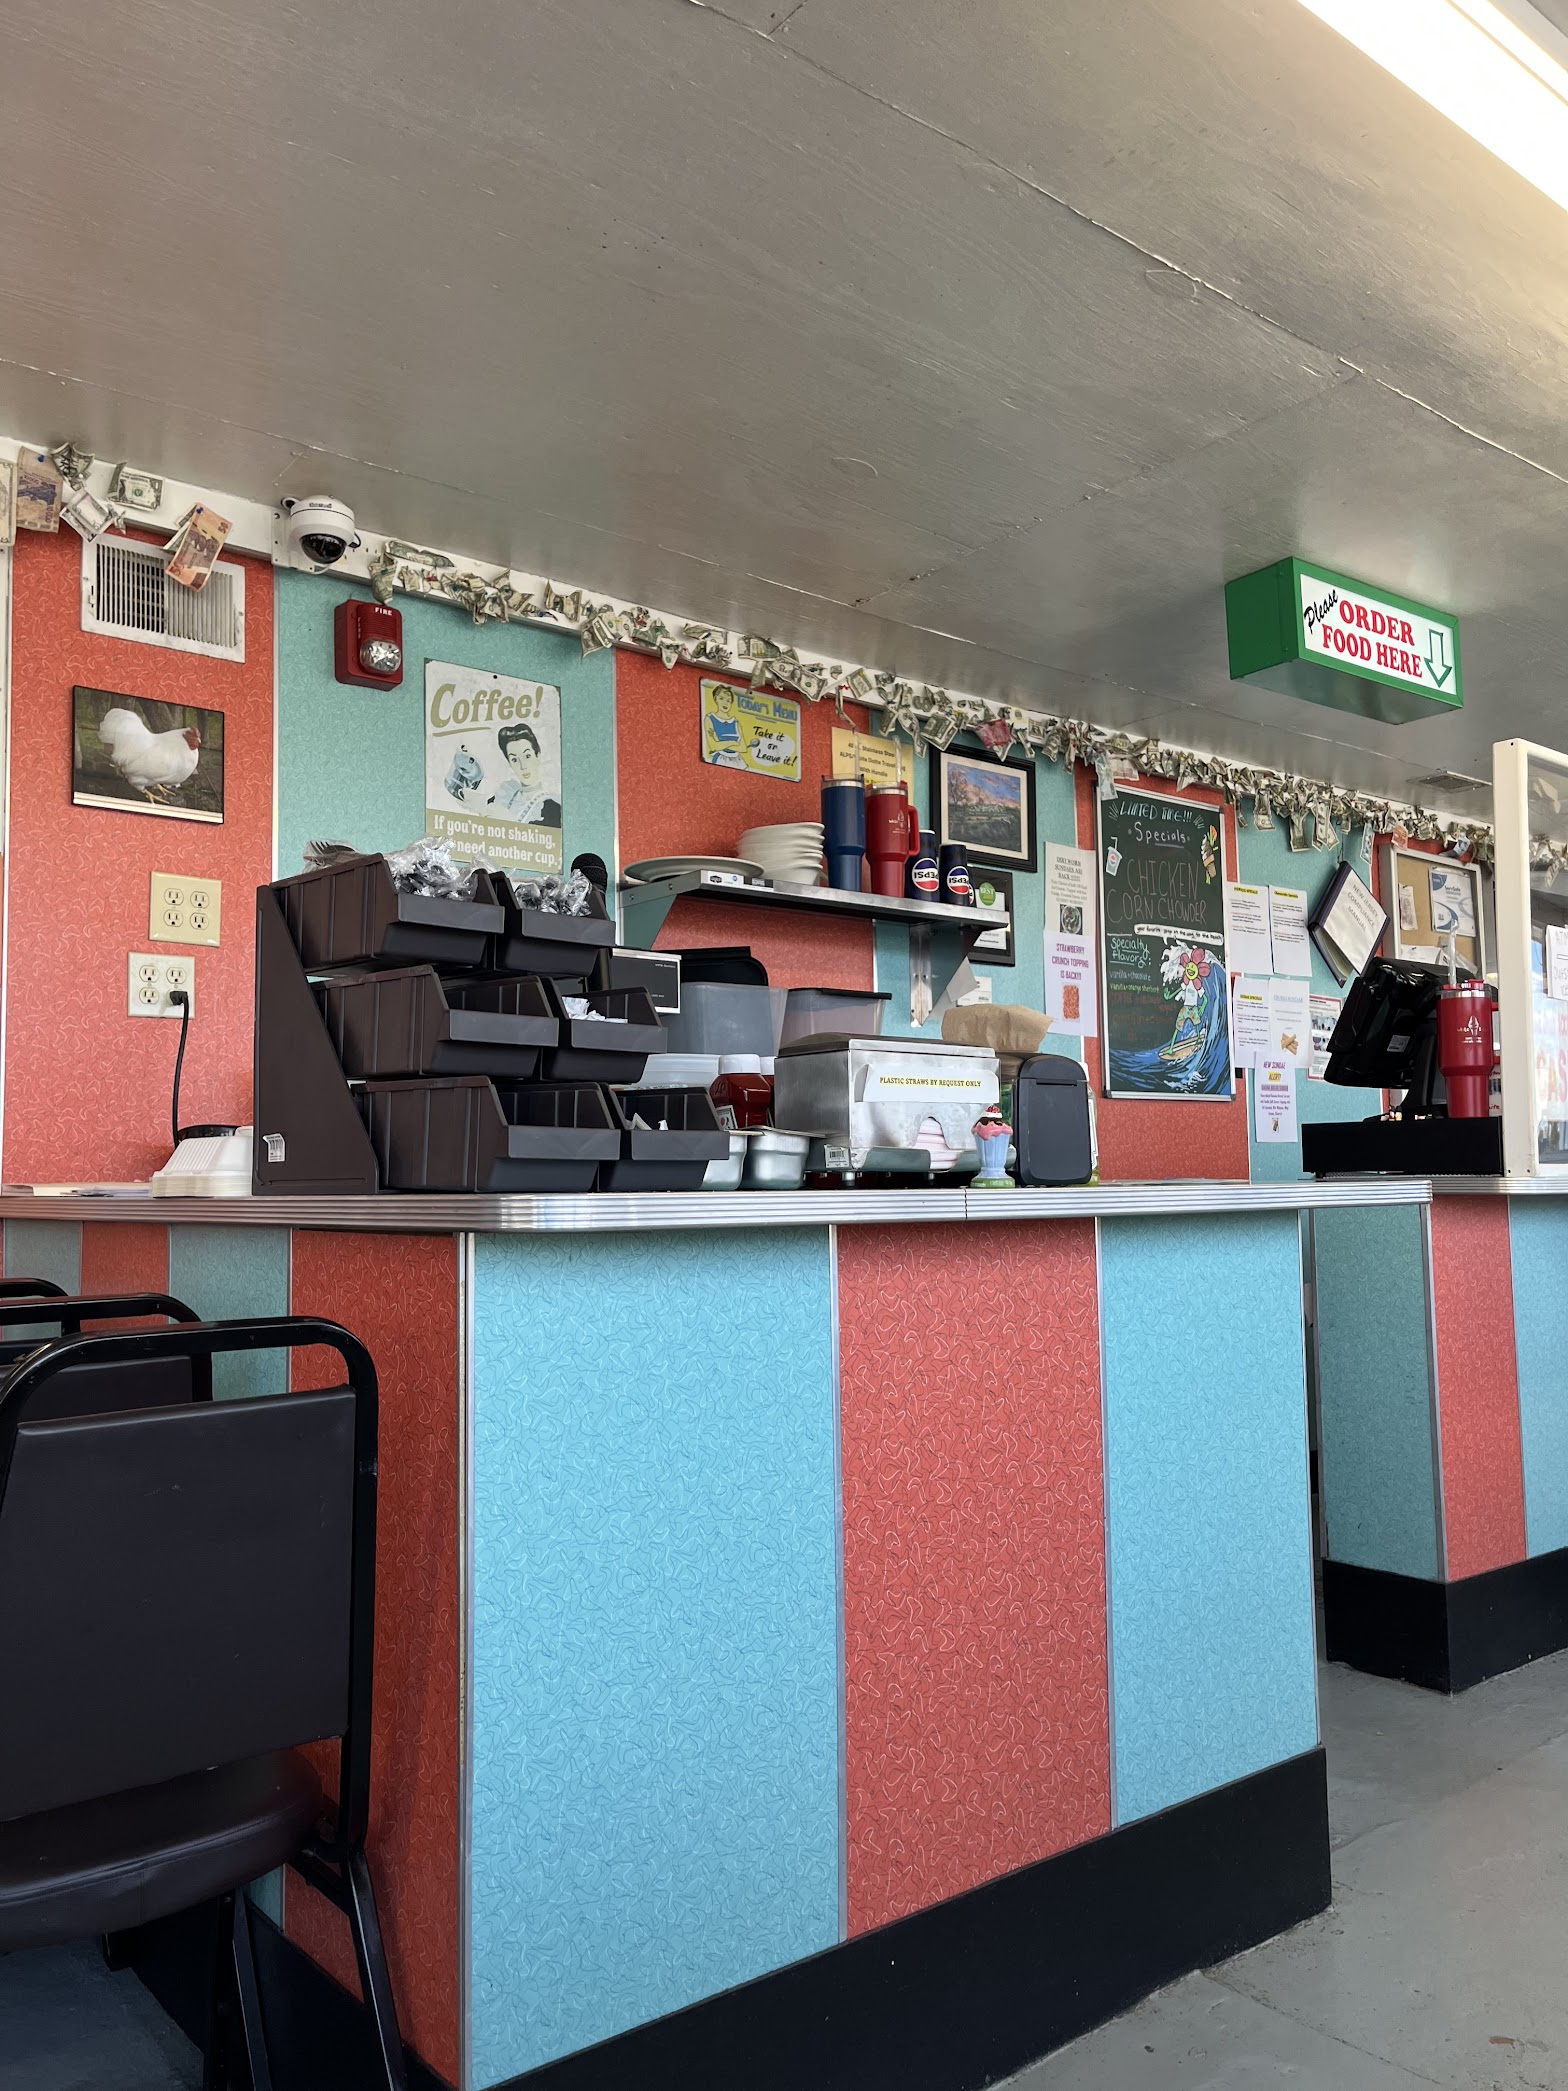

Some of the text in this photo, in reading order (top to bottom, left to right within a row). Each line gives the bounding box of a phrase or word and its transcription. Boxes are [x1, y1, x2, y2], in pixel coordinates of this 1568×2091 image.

[374, 606, 393, 617] FIRE
[1303, 589, 1339, 635] Please
[1339, 600, 1416, 646] ORDER
[1322, 623, 1423, 678] FOOD HERE
[430, 683, 544, 729] Coffee!
[753, 726, 785, 743] Take it
[756, 748, 798, 767] Leave it!
[767, 743, 778, 751] or
[434, 814, 556, 849] If you're not shaking,
[1134, 821, 1186, 844] Specials
[488, 844, 533, 863] another
[535, 850, 558, 868] cup.
[1127, 858, 1199, 900] CHICKEN
[980, 886, 994, 896] BEST
[1106, 888, 1154, 924] CORN
[1157, 897, 1207, 925] CHOWDER
[1055, 943, 1085, 955] STRAWBERRY
[1051, 955, 1089, 969] CRUNCH TOPPING
[879, 1076, 905, 1085] PLASTIC
[905, 1078, 929, 1086] STRAWS
[939, 1079, 965, 1088] REQUEST
[1536, 1048, 1568, 1103] CAS
